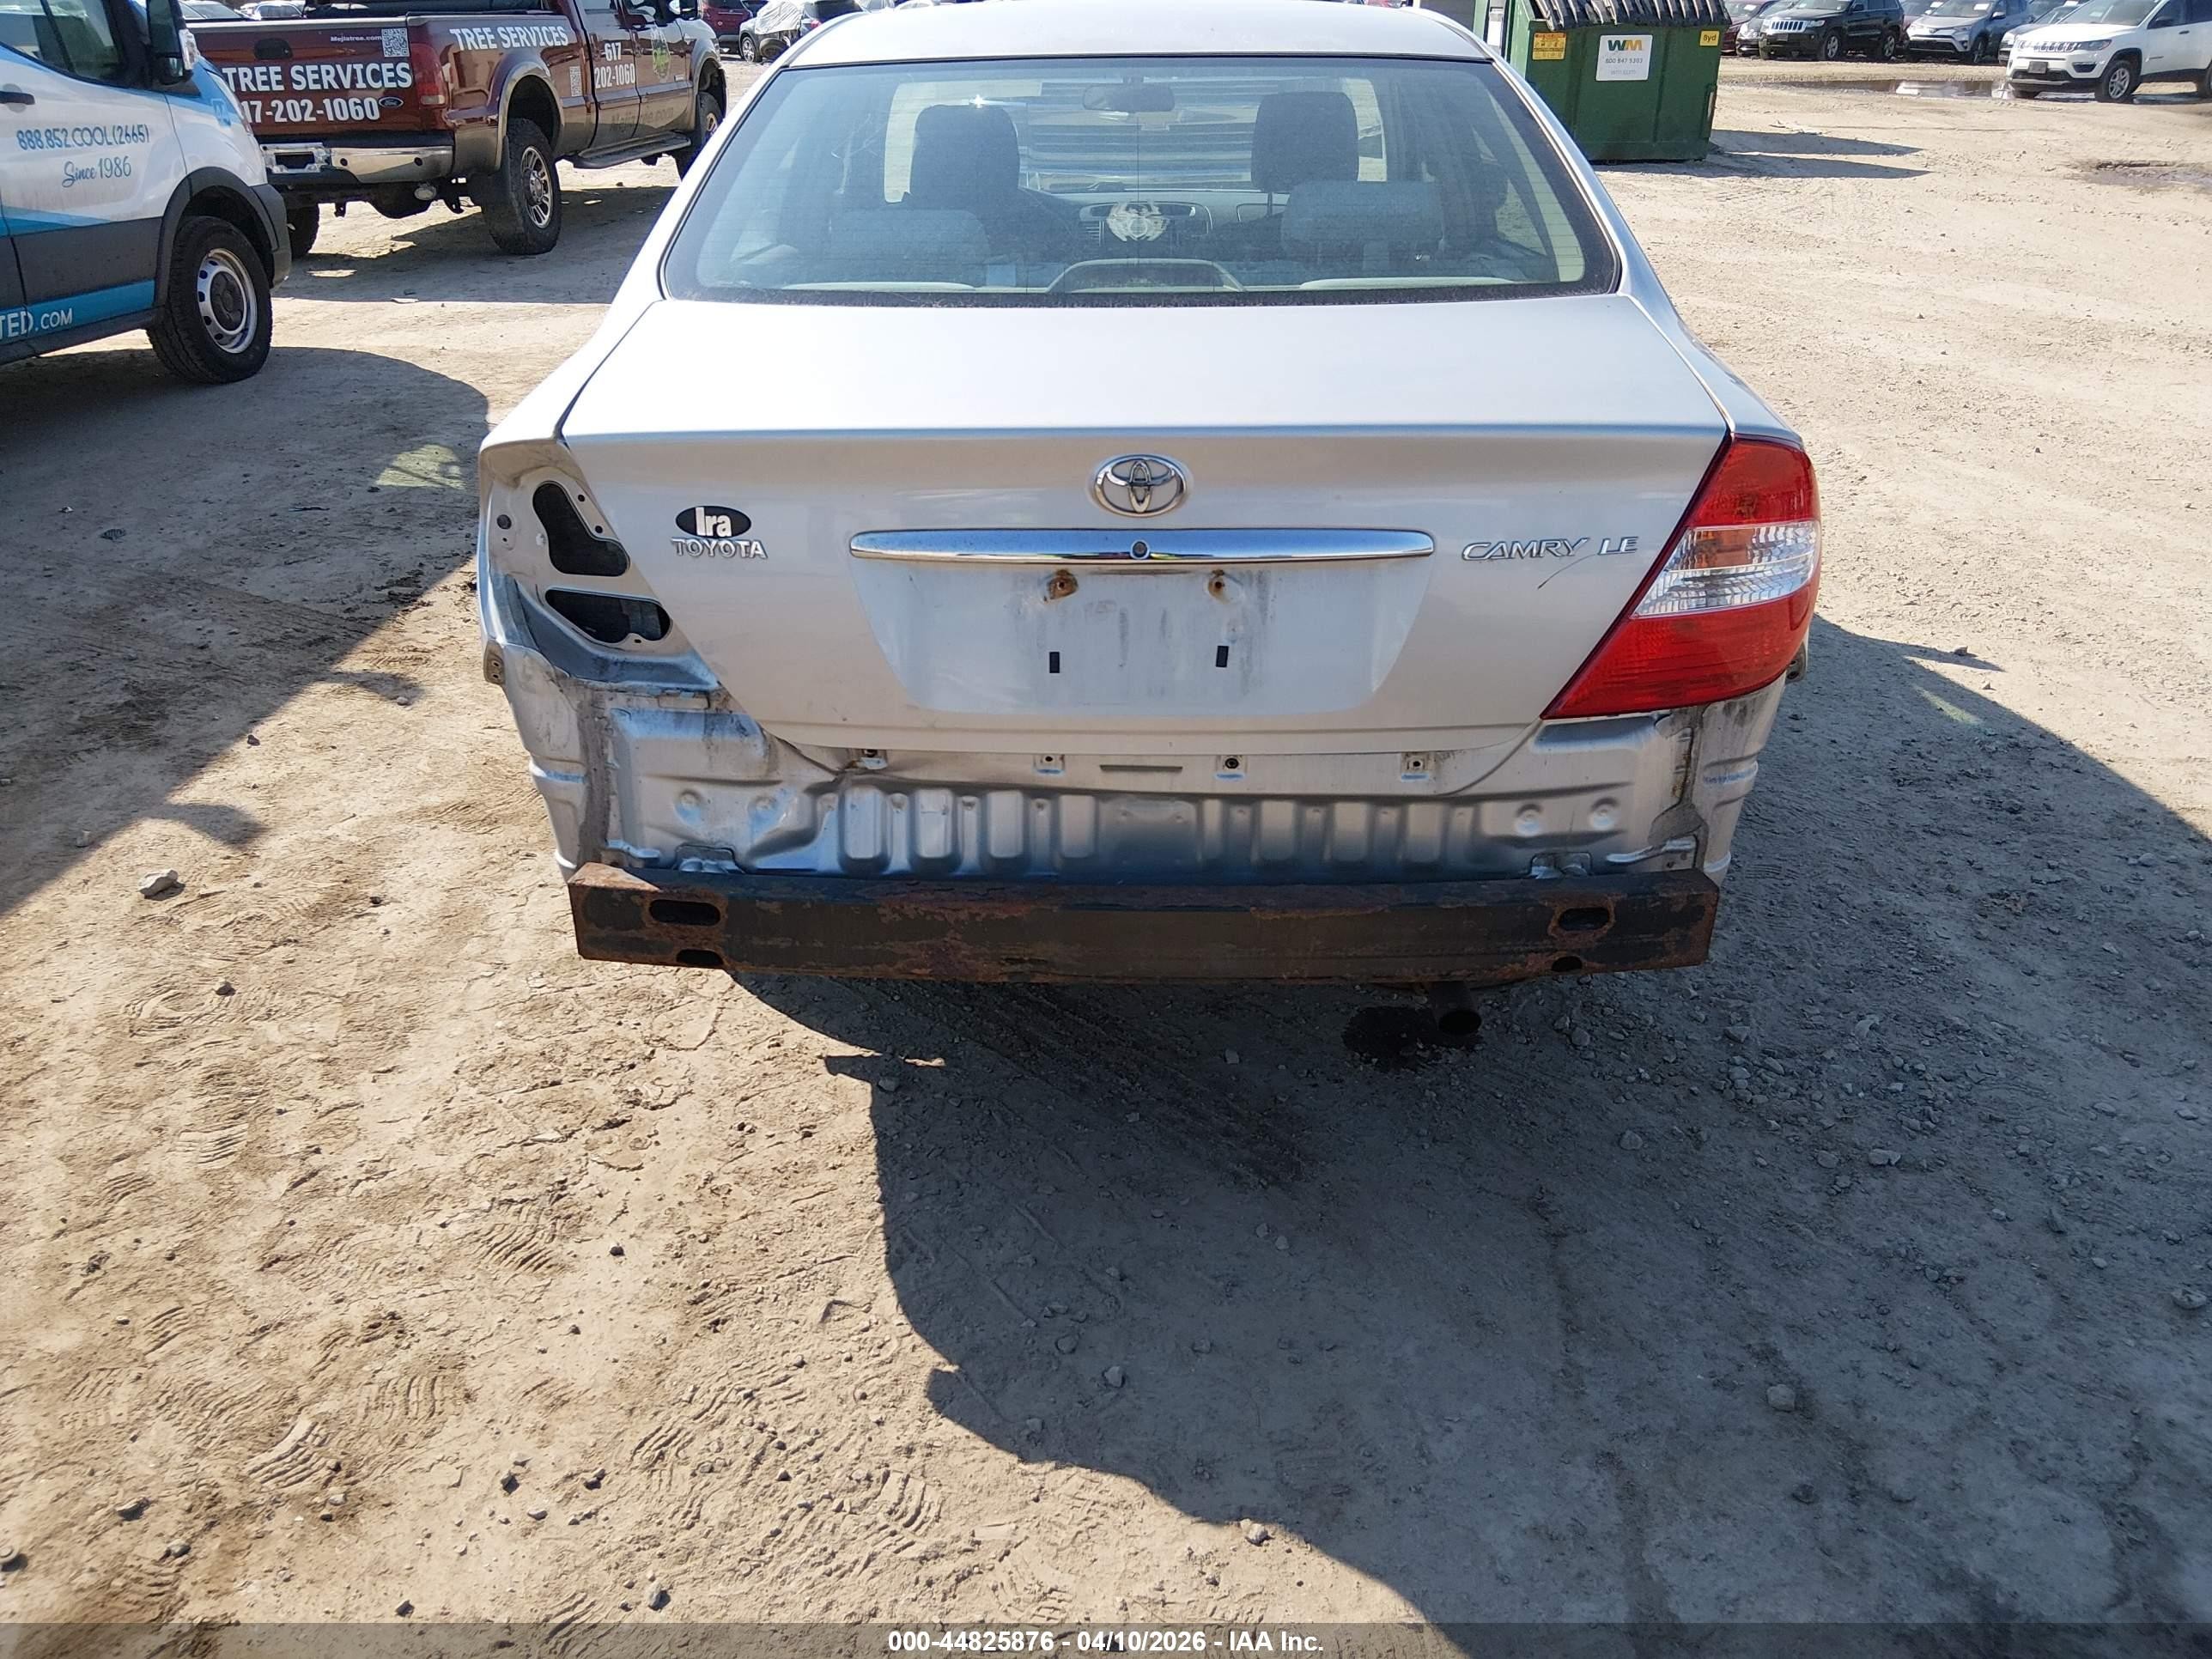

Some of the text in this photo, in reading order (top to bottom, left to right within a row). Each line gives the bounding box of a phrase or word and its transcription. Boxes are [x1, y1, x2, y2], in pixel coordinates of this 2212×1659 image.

[449, 26, 568, 51] TREE SERVICES
[1607, 40, 1643, 51] WM
[605, 42, 622, 62] 617
[222, 62, 413, 92] TREE SERVICES
[594, 63, 636, 89] 202-1060
[16, 124, 150, 150] 888.852.COOL(2665)
[62, 155, 131, 188] Since 1986
[696, 507, 732, 538] Ira
[672, 538, 769, 559] TOYOTA
[1462, 537, 1638, 561] CAMRY LE
